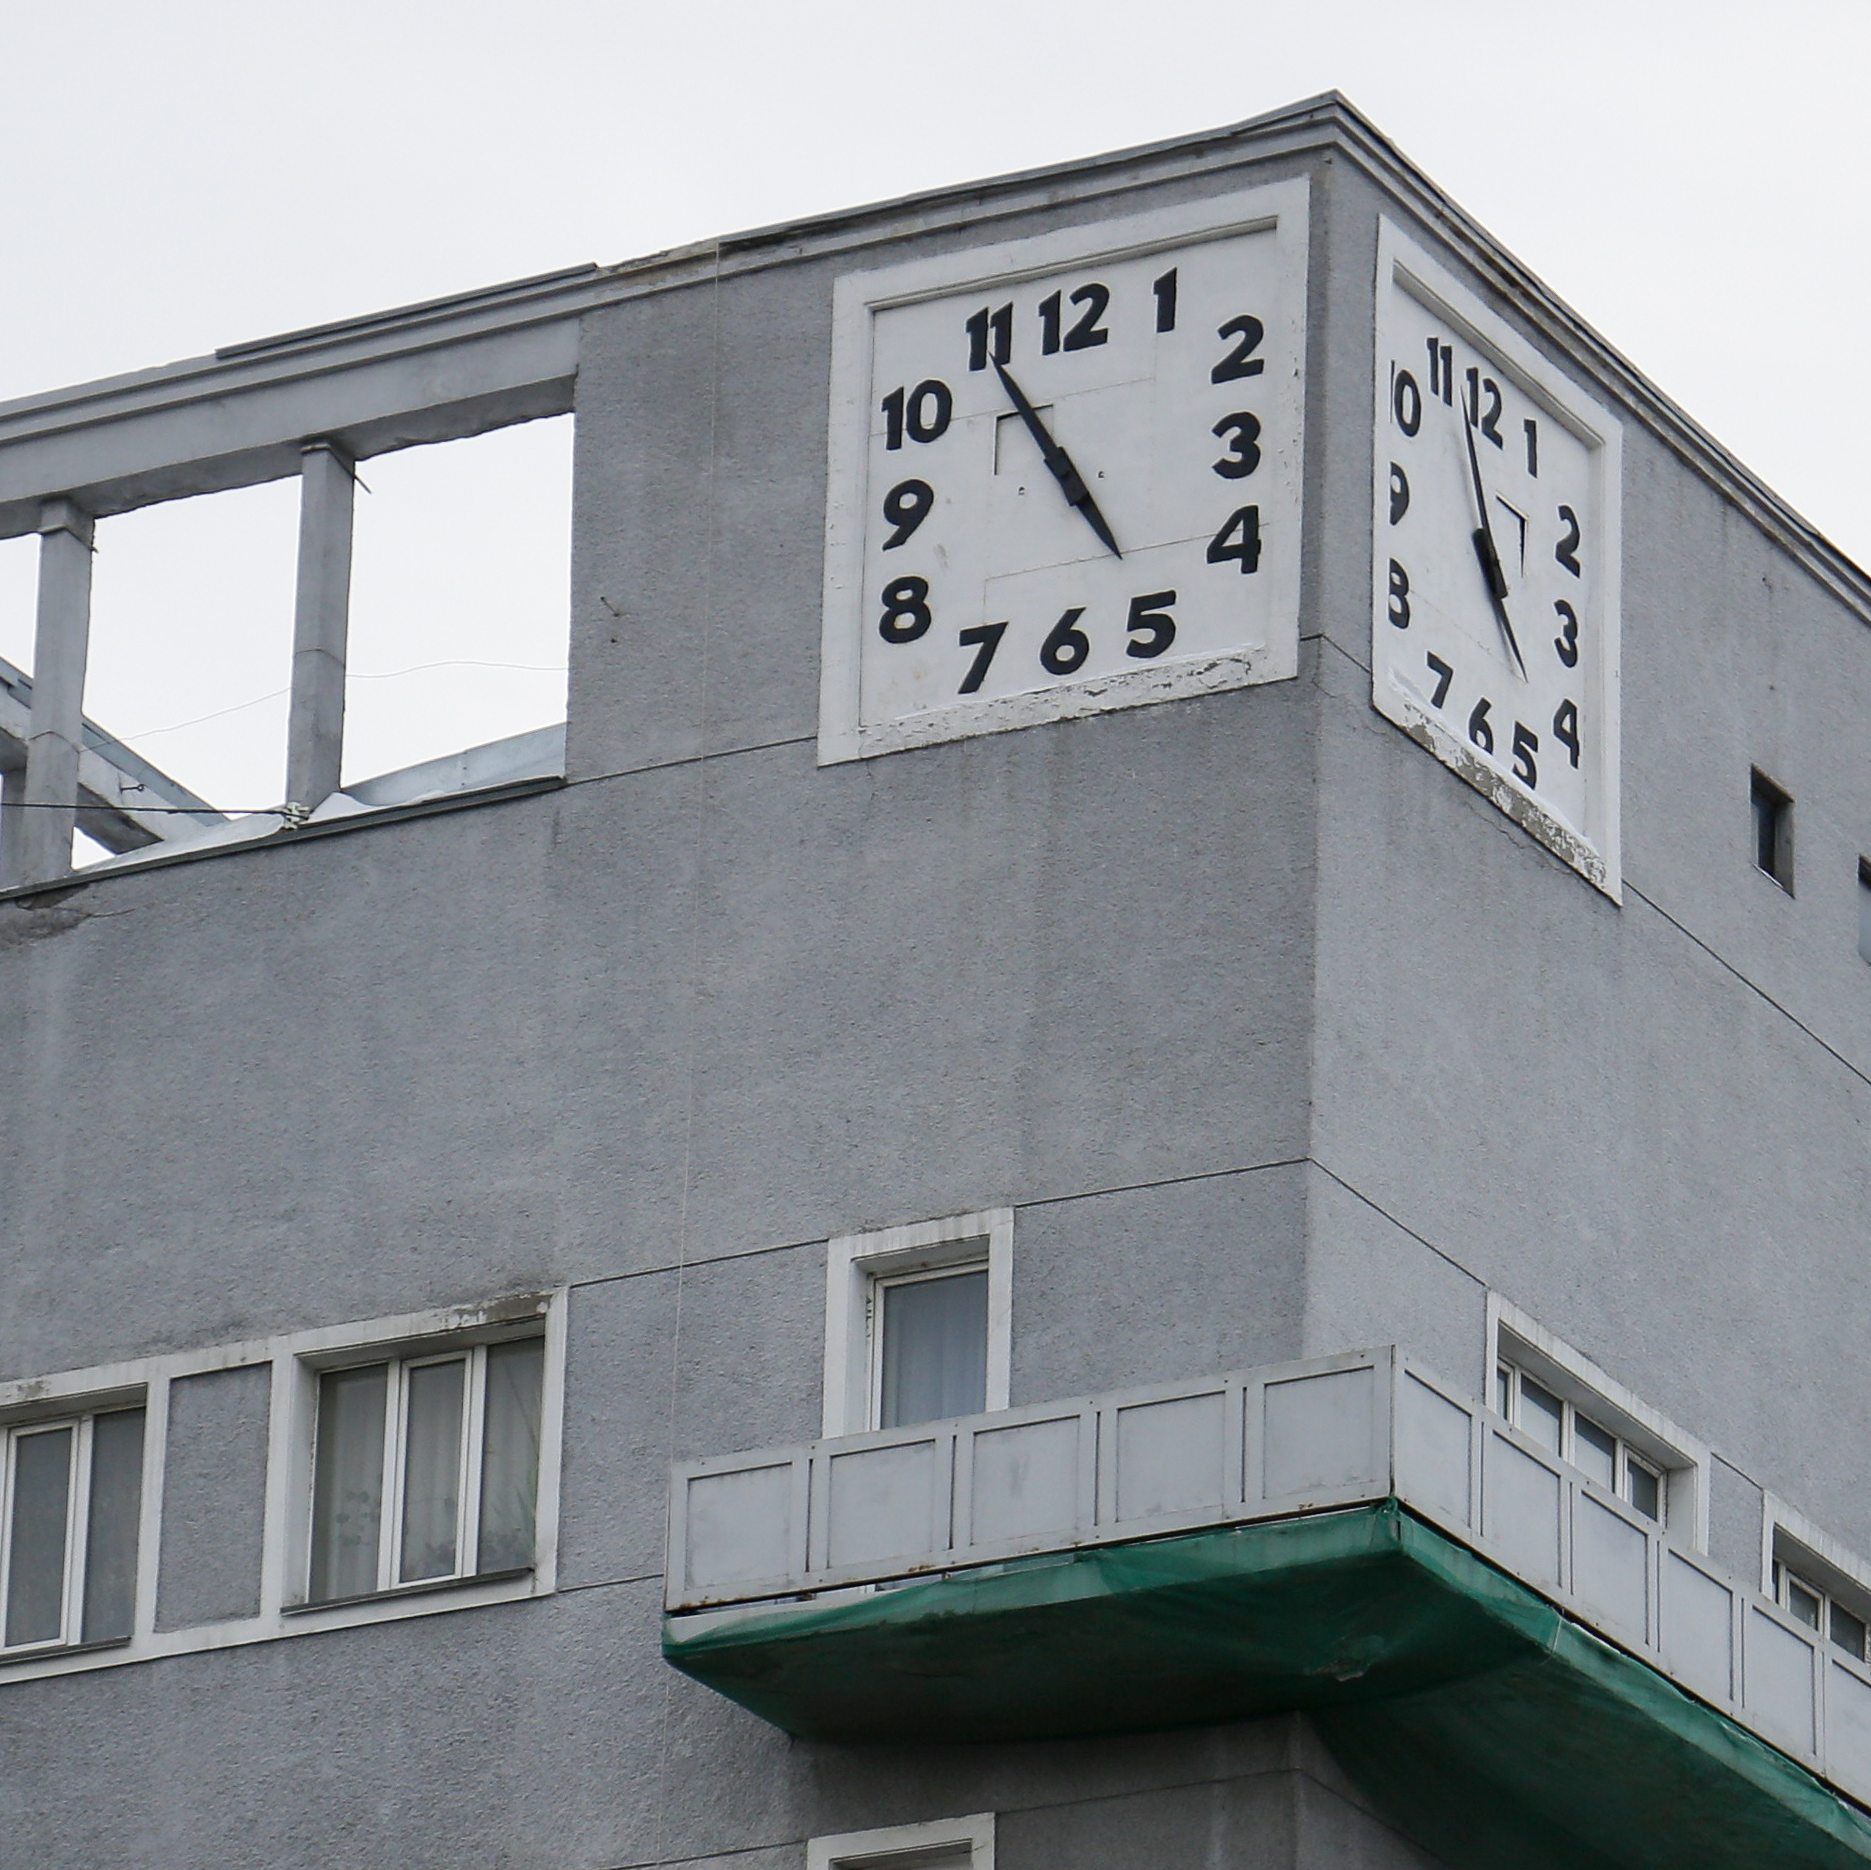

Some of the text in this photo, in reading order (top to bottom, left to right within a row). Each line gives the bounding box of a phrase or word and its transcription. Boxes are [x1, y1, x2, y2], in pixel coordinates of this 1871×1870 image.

[1038, 282, 1110, 356] 12
[1154, 267, 1177, 333] 1
[965, 301, 1013, 372] 11
[1211, 314, 1265, 384] 2
[1426, 337, 1454, 407] 11
[881, 379, 953, 451] 10
[1466, 366, 1504, 450] 12
[1211, 411, 1262, 480] 3
[1523, 418, 1538, 478] 1
[882, 478, 935, 552] 9
[1206, 504, 1262, 575] 4
[1555, 504, 1581, 579] 2
[878, 575, 932, 645] 8
[1039, 606, 1090, 676] 6
[1125, 589, 1177, 659] 5
[1553, 600, 1579, 669] 3
[957, 621, 1009, 695] 7
[1426, 651, 1454, 710] 7
[1468, 697, 1494, 757] 6
[1512, 720, 1539, 792] 5
[1553, 698, 1580, 770] 4
